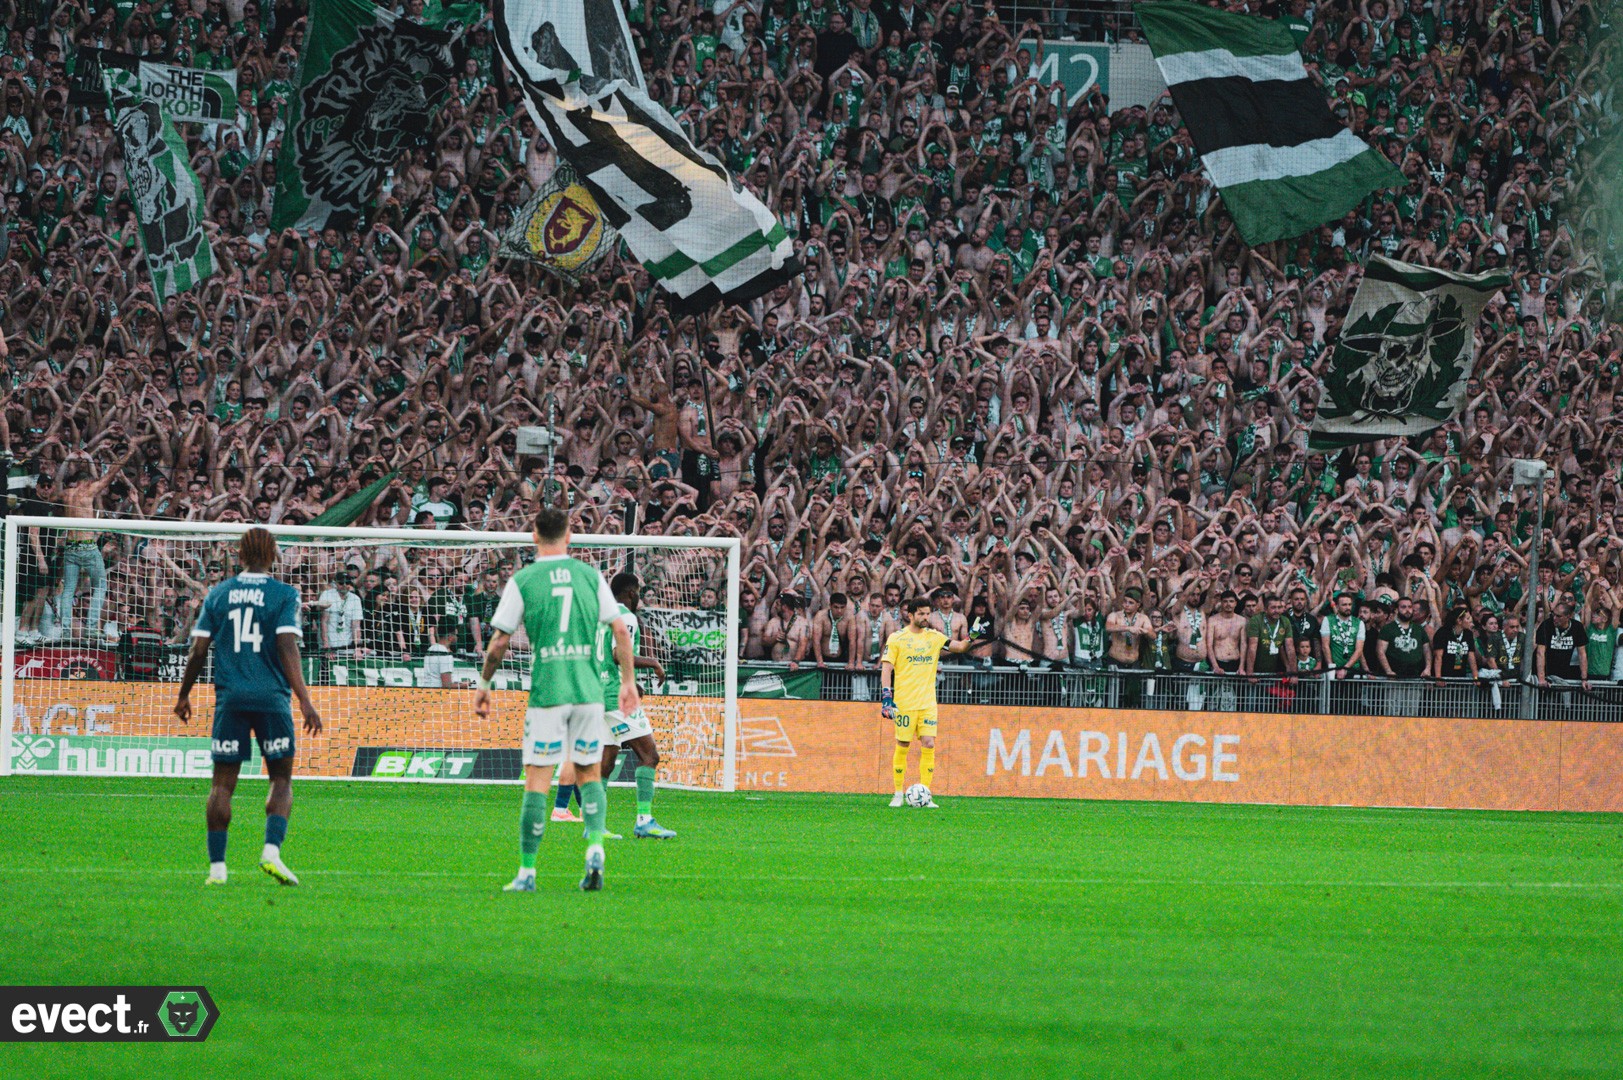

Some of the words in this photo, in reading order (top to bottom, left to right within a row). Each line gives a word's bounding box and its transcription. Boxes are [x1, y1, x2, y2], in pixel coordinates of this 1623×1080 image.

[167, 69, 204, 86] THE
[161, 100, 201, 116] KOP
[549, 567, 571, 584] LÉO
[228, 588, 265, 607] ISMAËL
[551, 586, 573, 633] 7
[228, 607, 264, 653] 14
[895, 714, 910, 728] 30
[59, 738, 213, 774] humme
[375, 752, 474, 776] BKT
[986, 728, 1241, 782] MARIAGE
